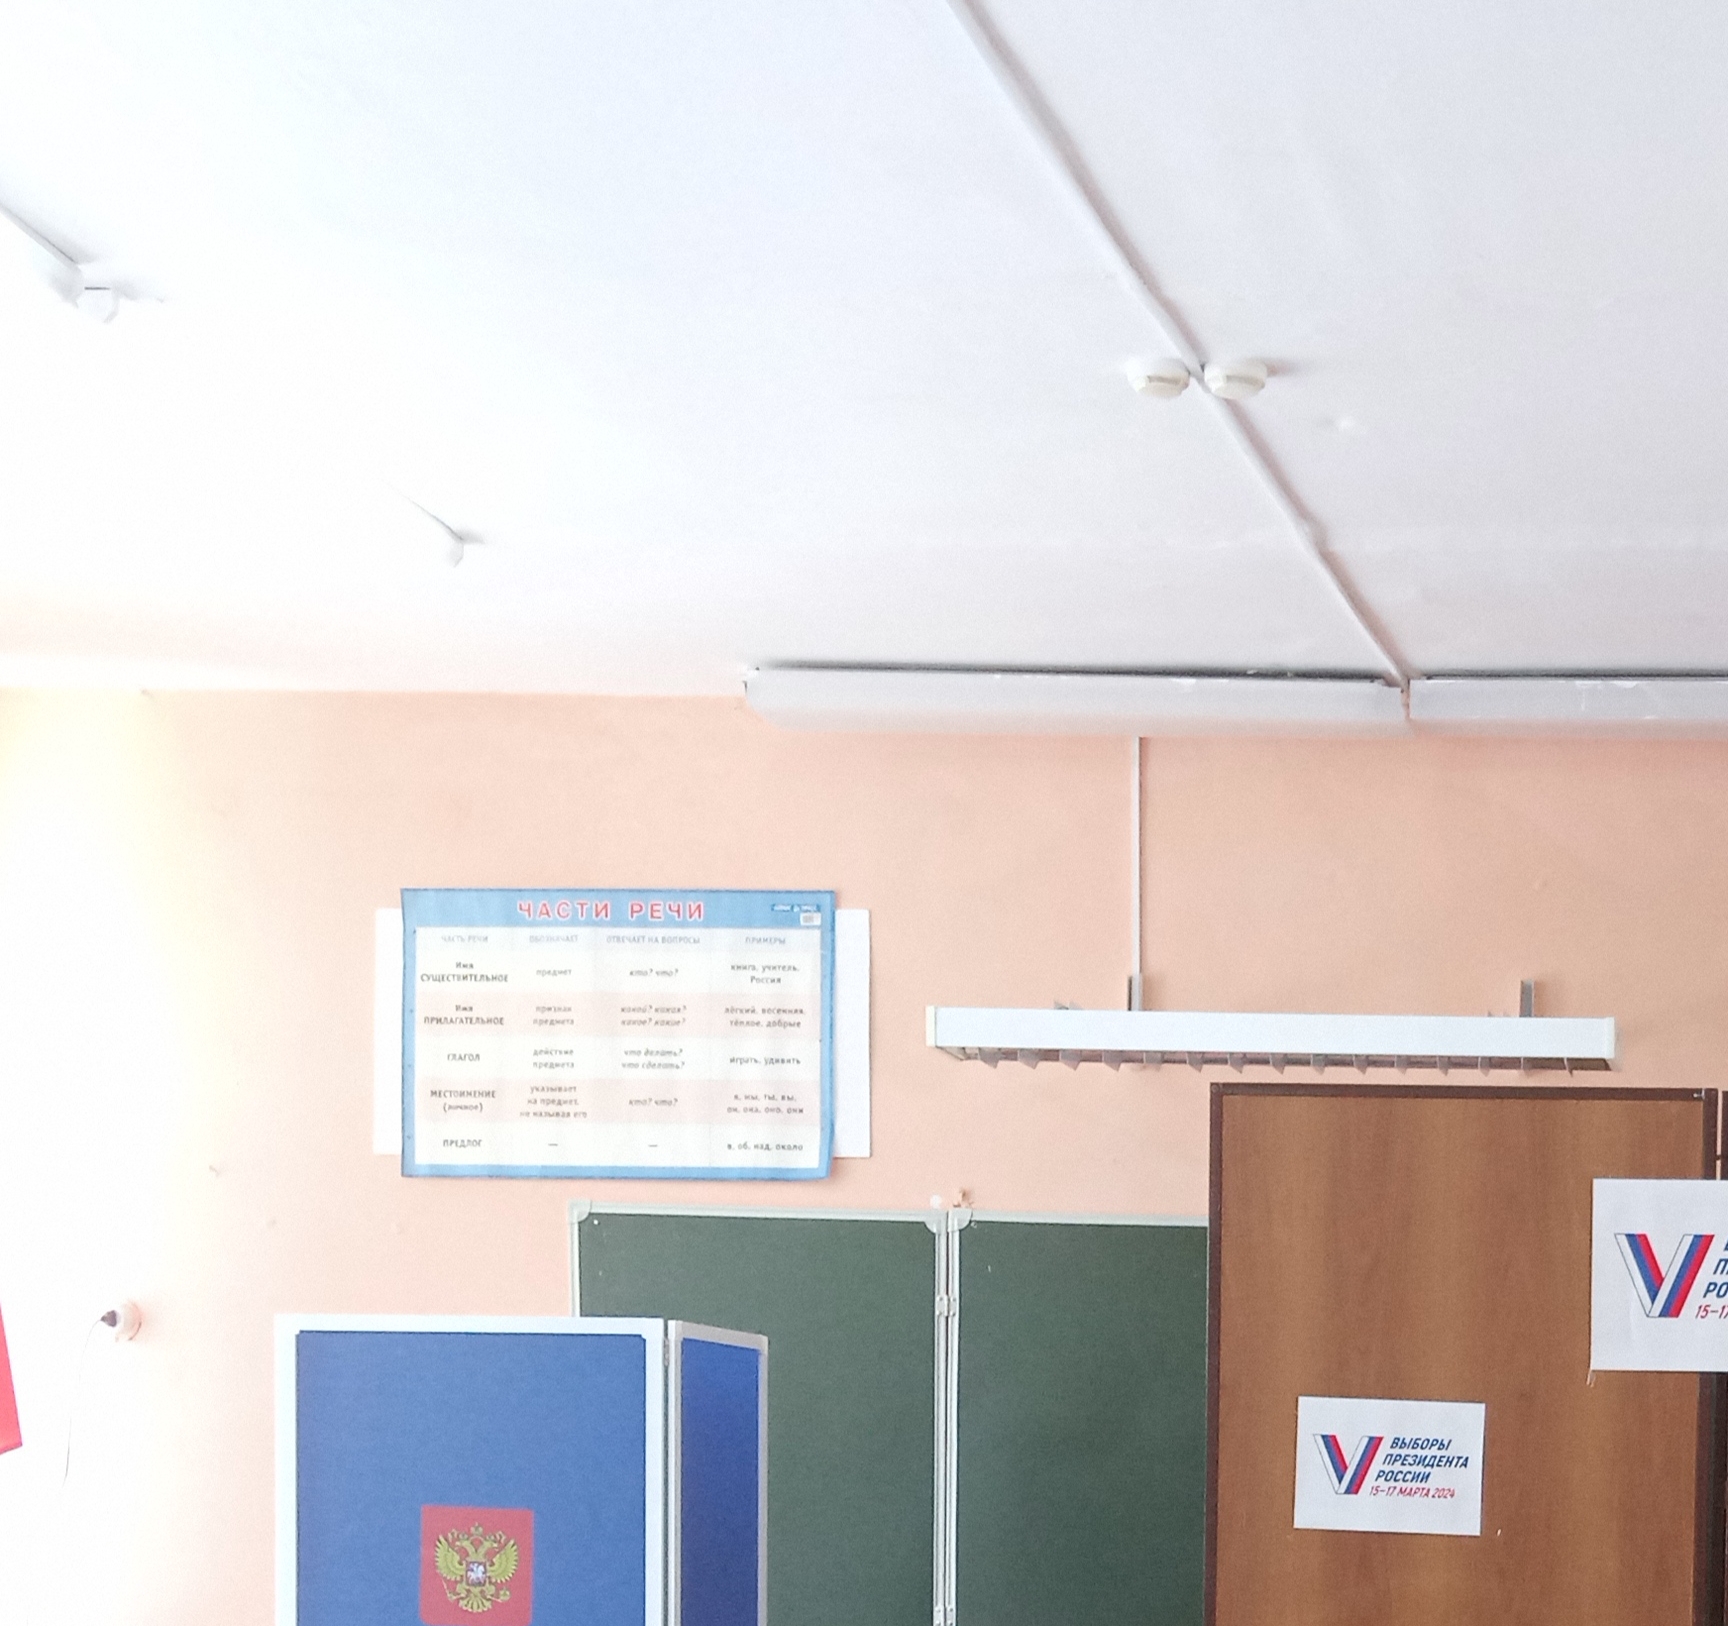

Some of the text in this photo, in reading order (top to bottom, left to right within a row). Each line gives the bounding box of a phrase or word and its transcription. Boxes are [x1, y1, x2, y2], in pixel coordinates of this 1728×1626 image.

[518, 902, 704, 921] ЧАСТИ РЕЧИ
[441, 935, 488, 943] ЧАСТЬ РЕЧИ
[606, 936, 700, 944] ОТВЕЧАЕТ НА ВОПРОСЫ
[745, 937, 786, 945] ПРИМЕРЫ
[629, 968, 679, 977] кто? что?
[420, 974, 508, 983] СУЩЕСТВИТЕЛЬНОЕ
[750, 976, 782, 984] Россия
[424, 1017, 504, 1025] ПРИЛАГАТЕЛЬНОЕ
[766, 1020, 801, 1029] добрые
[447, 1053, 480, 1062] ГЛАГОЛ
[621, 1061, 640, 1069] что
[430, 1090, 496, 1098] МЕСТОИМЕНИЕ
[628, 1098, 678, 1106] кто? что?
[443, 1139, 482, 1148] ПРЕДЛОГ
[775, 1143, 804, 1151] около
[1390, 1437, 1452, 1450] ВЫБОРЫ
[1382, 1454, 1469, 1469] ПРЕЗИДЕНТА
[1375, 1470, 1431, 1483] РОССИИ
[1397, 1487, 1430, 1498] МАРТА
[1431, 1488, 1455, 1498] 2024
